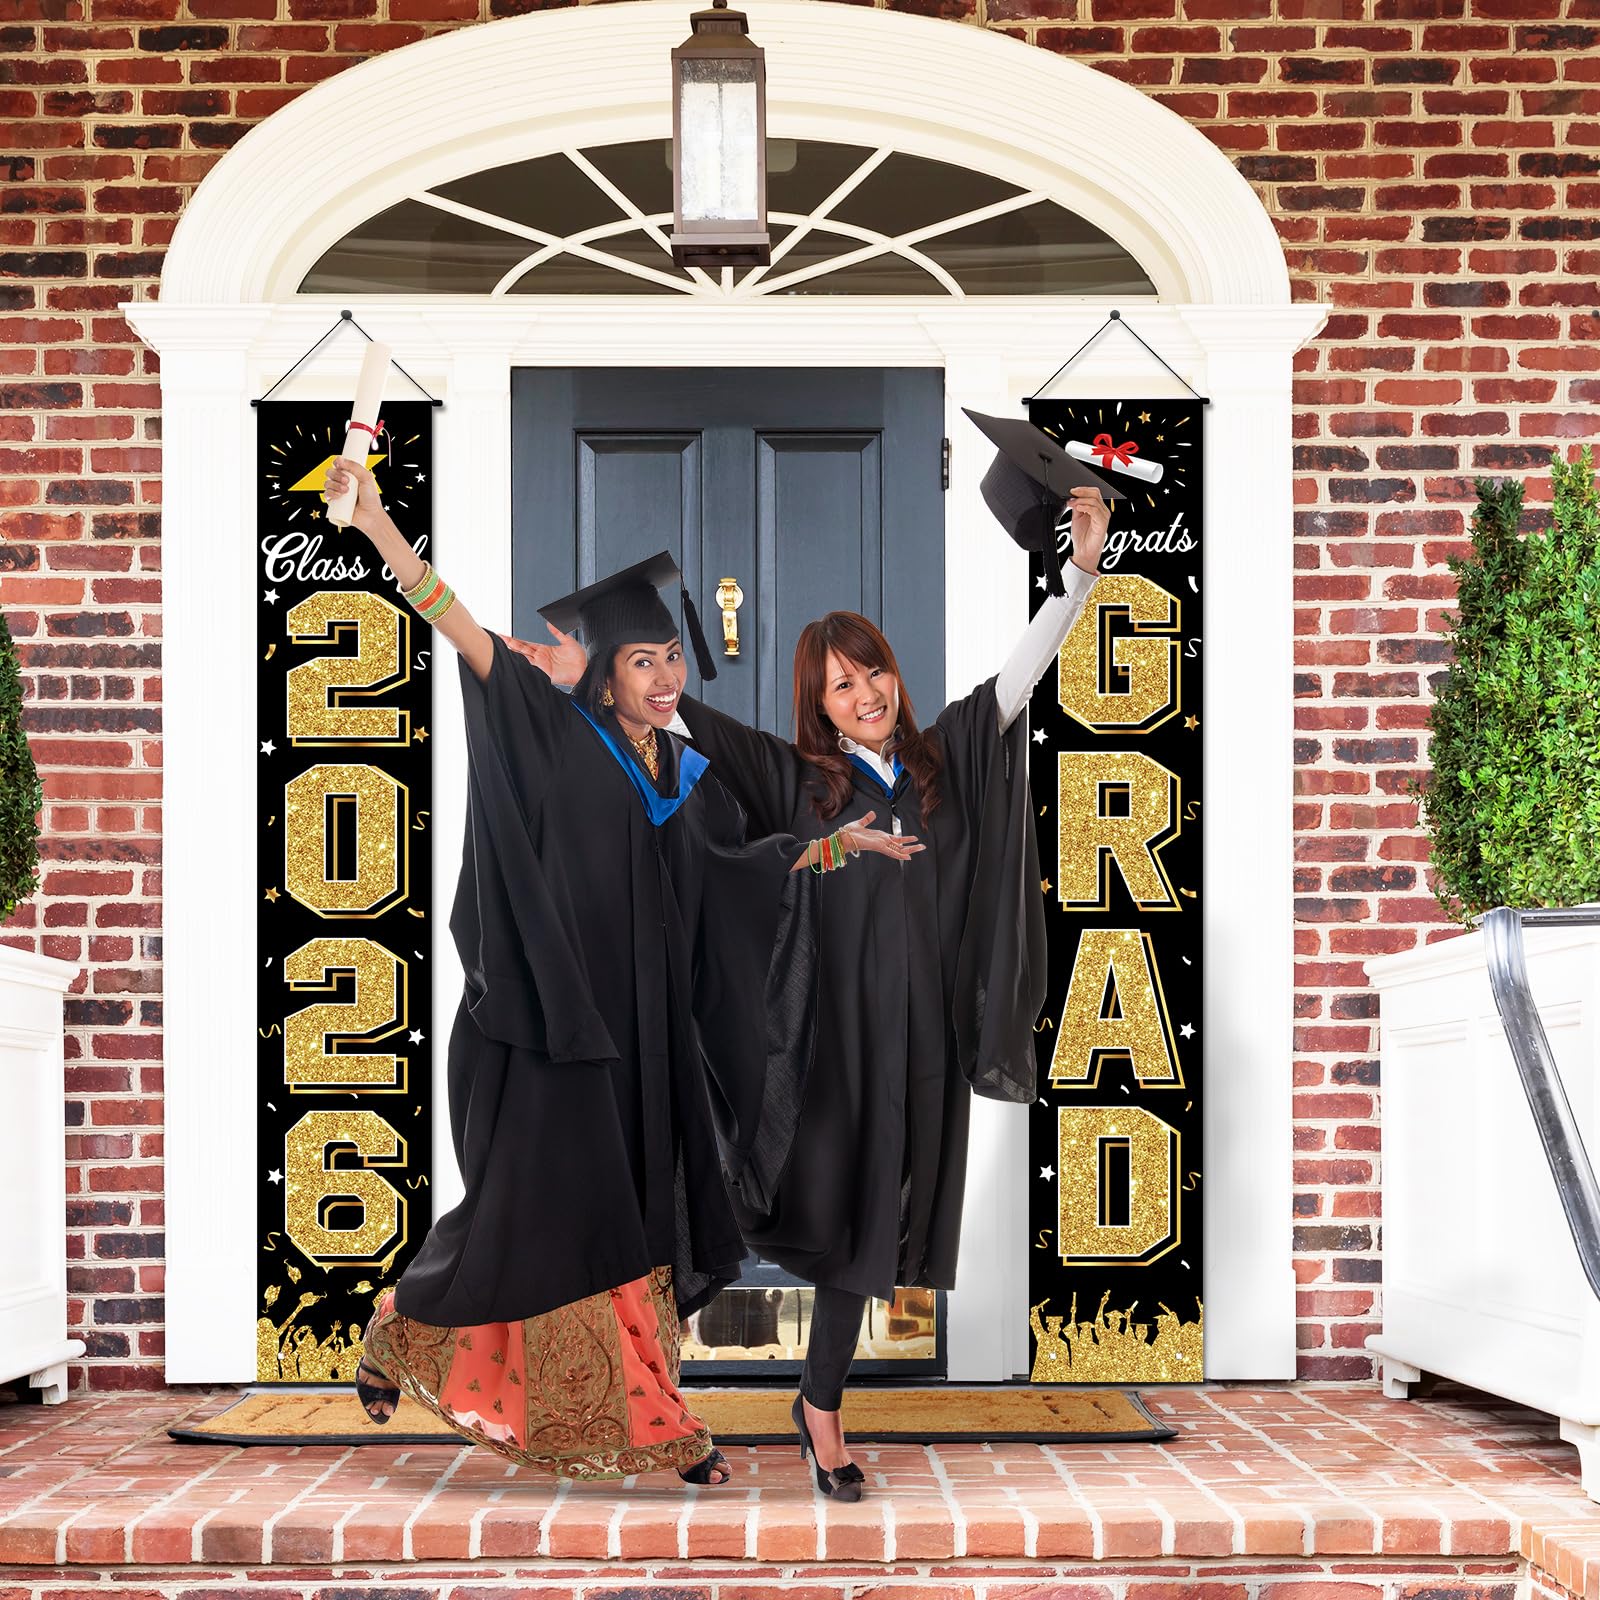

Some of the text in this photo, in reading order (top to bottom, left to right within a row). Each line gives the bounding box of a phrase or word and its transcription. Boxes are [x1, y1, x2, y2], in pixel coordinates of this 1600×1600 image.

[261, 531, 371, 582] Class
[284, 590, 411, 1268] 2026
[1047, 573, 1186, 1267] GRAD
